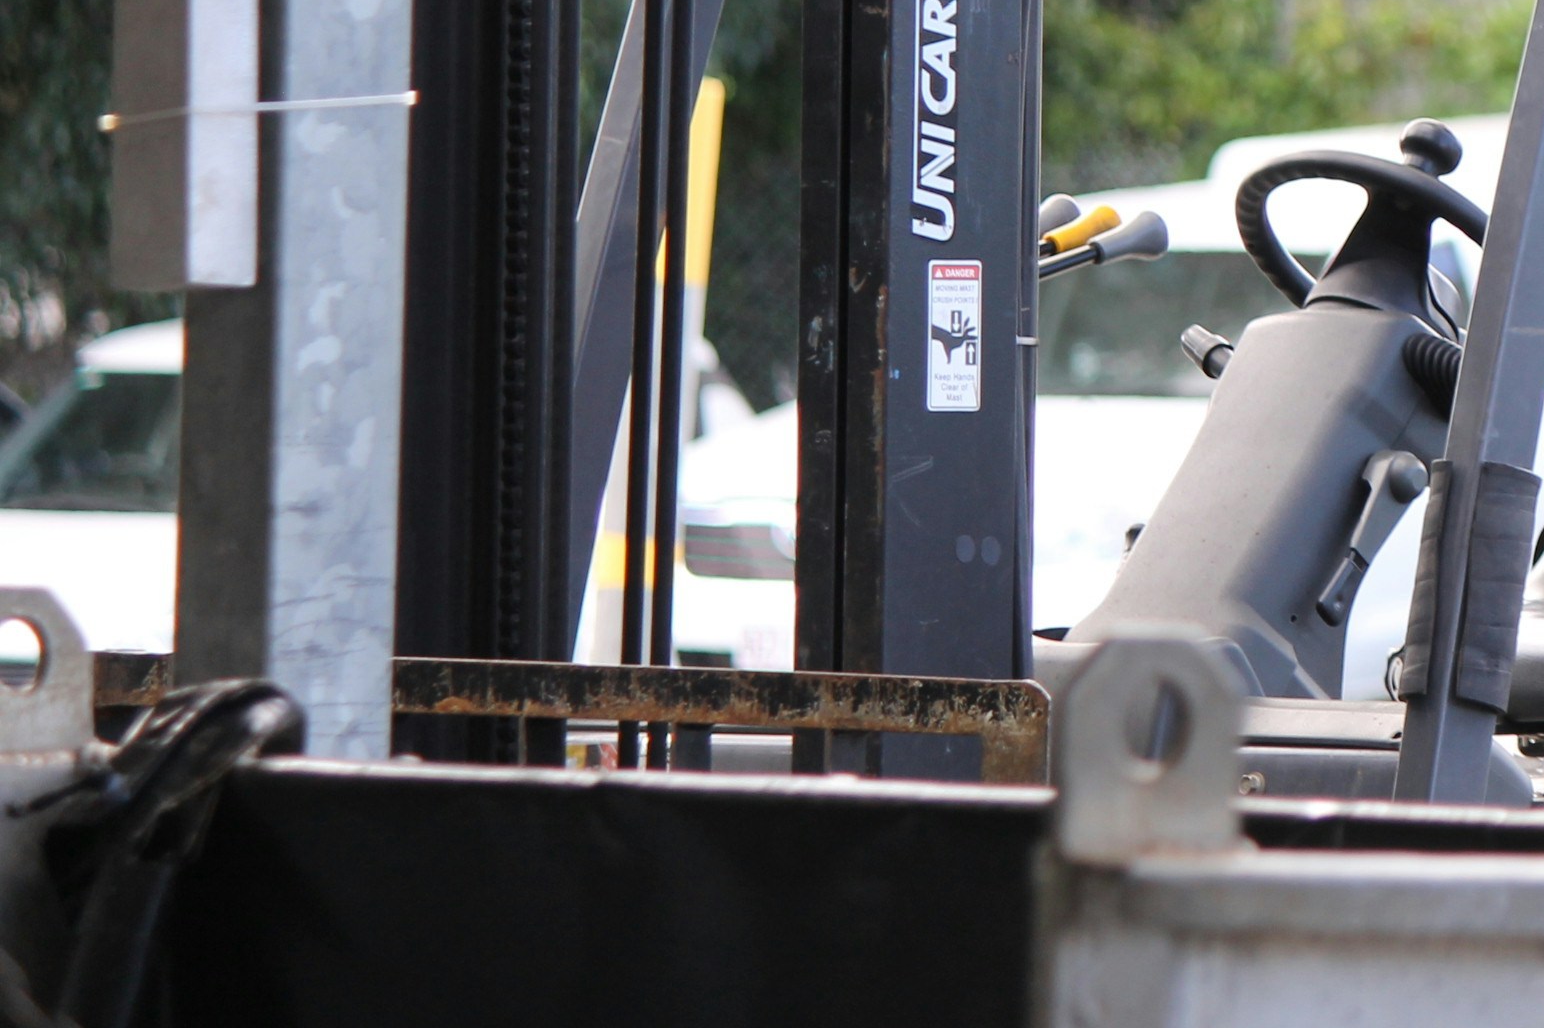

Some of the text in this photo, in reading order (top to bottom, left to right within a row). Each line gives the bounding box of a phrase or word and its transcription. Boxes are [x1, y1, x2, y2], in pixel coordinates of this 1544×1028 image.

[945, 268, 975, 278] DANGER
[934, 373, 975, 381] Keep Hands
[941, 383, 968, 391] Clear of
[946, 394, 962, 402] Mast
